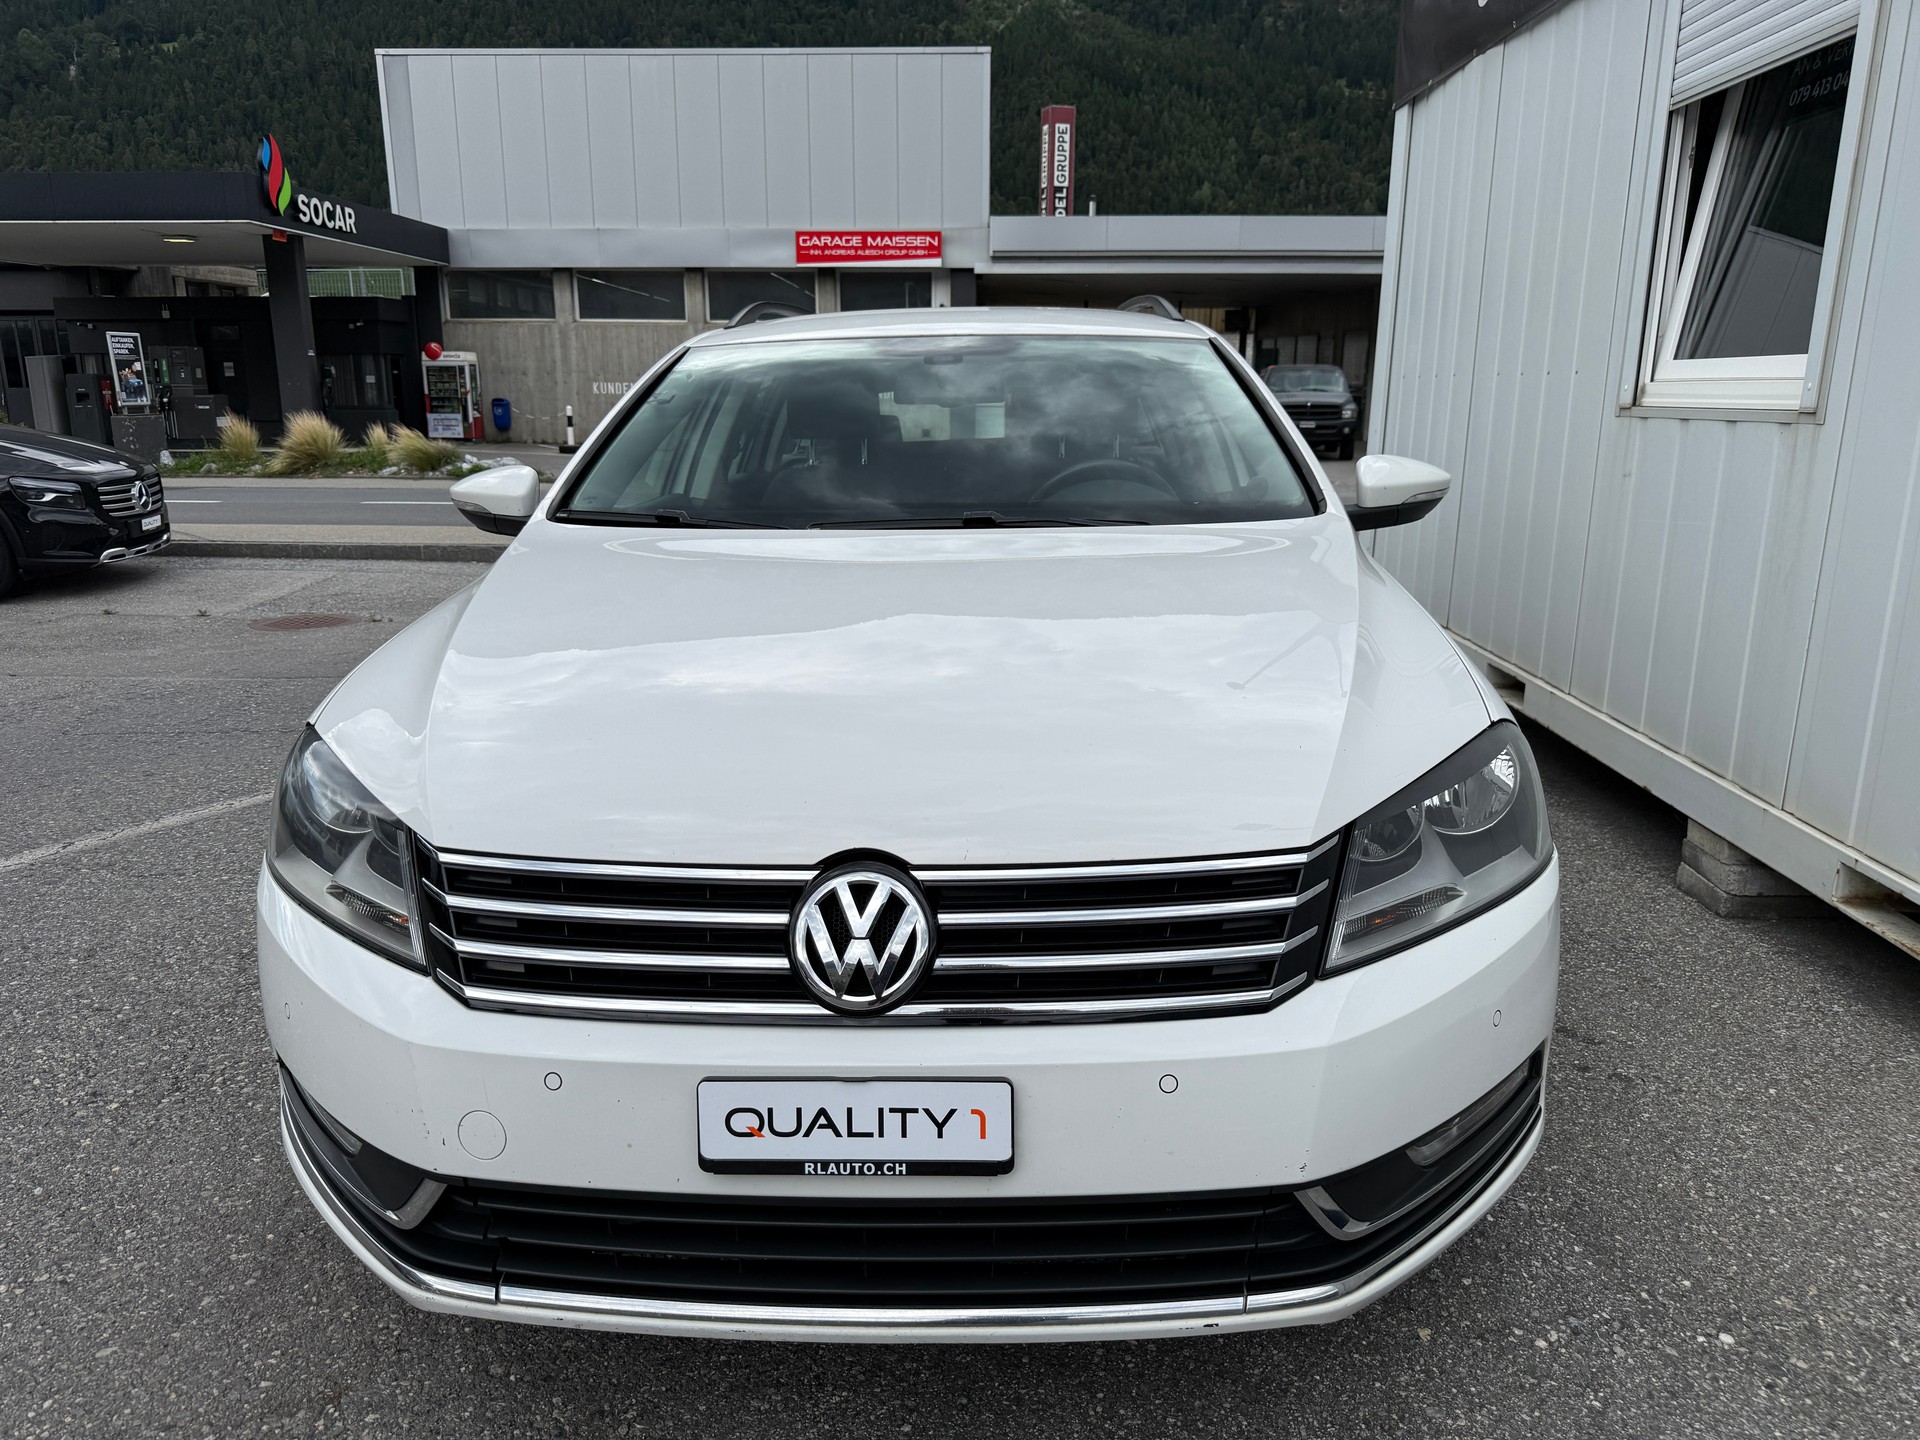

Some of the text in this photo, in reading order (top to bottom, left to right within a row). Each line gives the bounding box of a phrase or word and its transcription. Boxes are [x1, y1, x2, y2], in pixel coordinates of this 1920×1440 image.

[1789, 84, 1811, 107] 079
[1812, 76, 1833, 98] 413
[1056, 125, 1069, 184] GRUPPE
[297, 193, 357, 234] SOCAR
[799, 235, 939, 247] GARAGE MAISSEN
[593, 382, 634, 394] KUNDE
[724, 1106, 987, 1140] QUALITY 1
[804, 1162, 907, 1175] RLAUTO.CH
